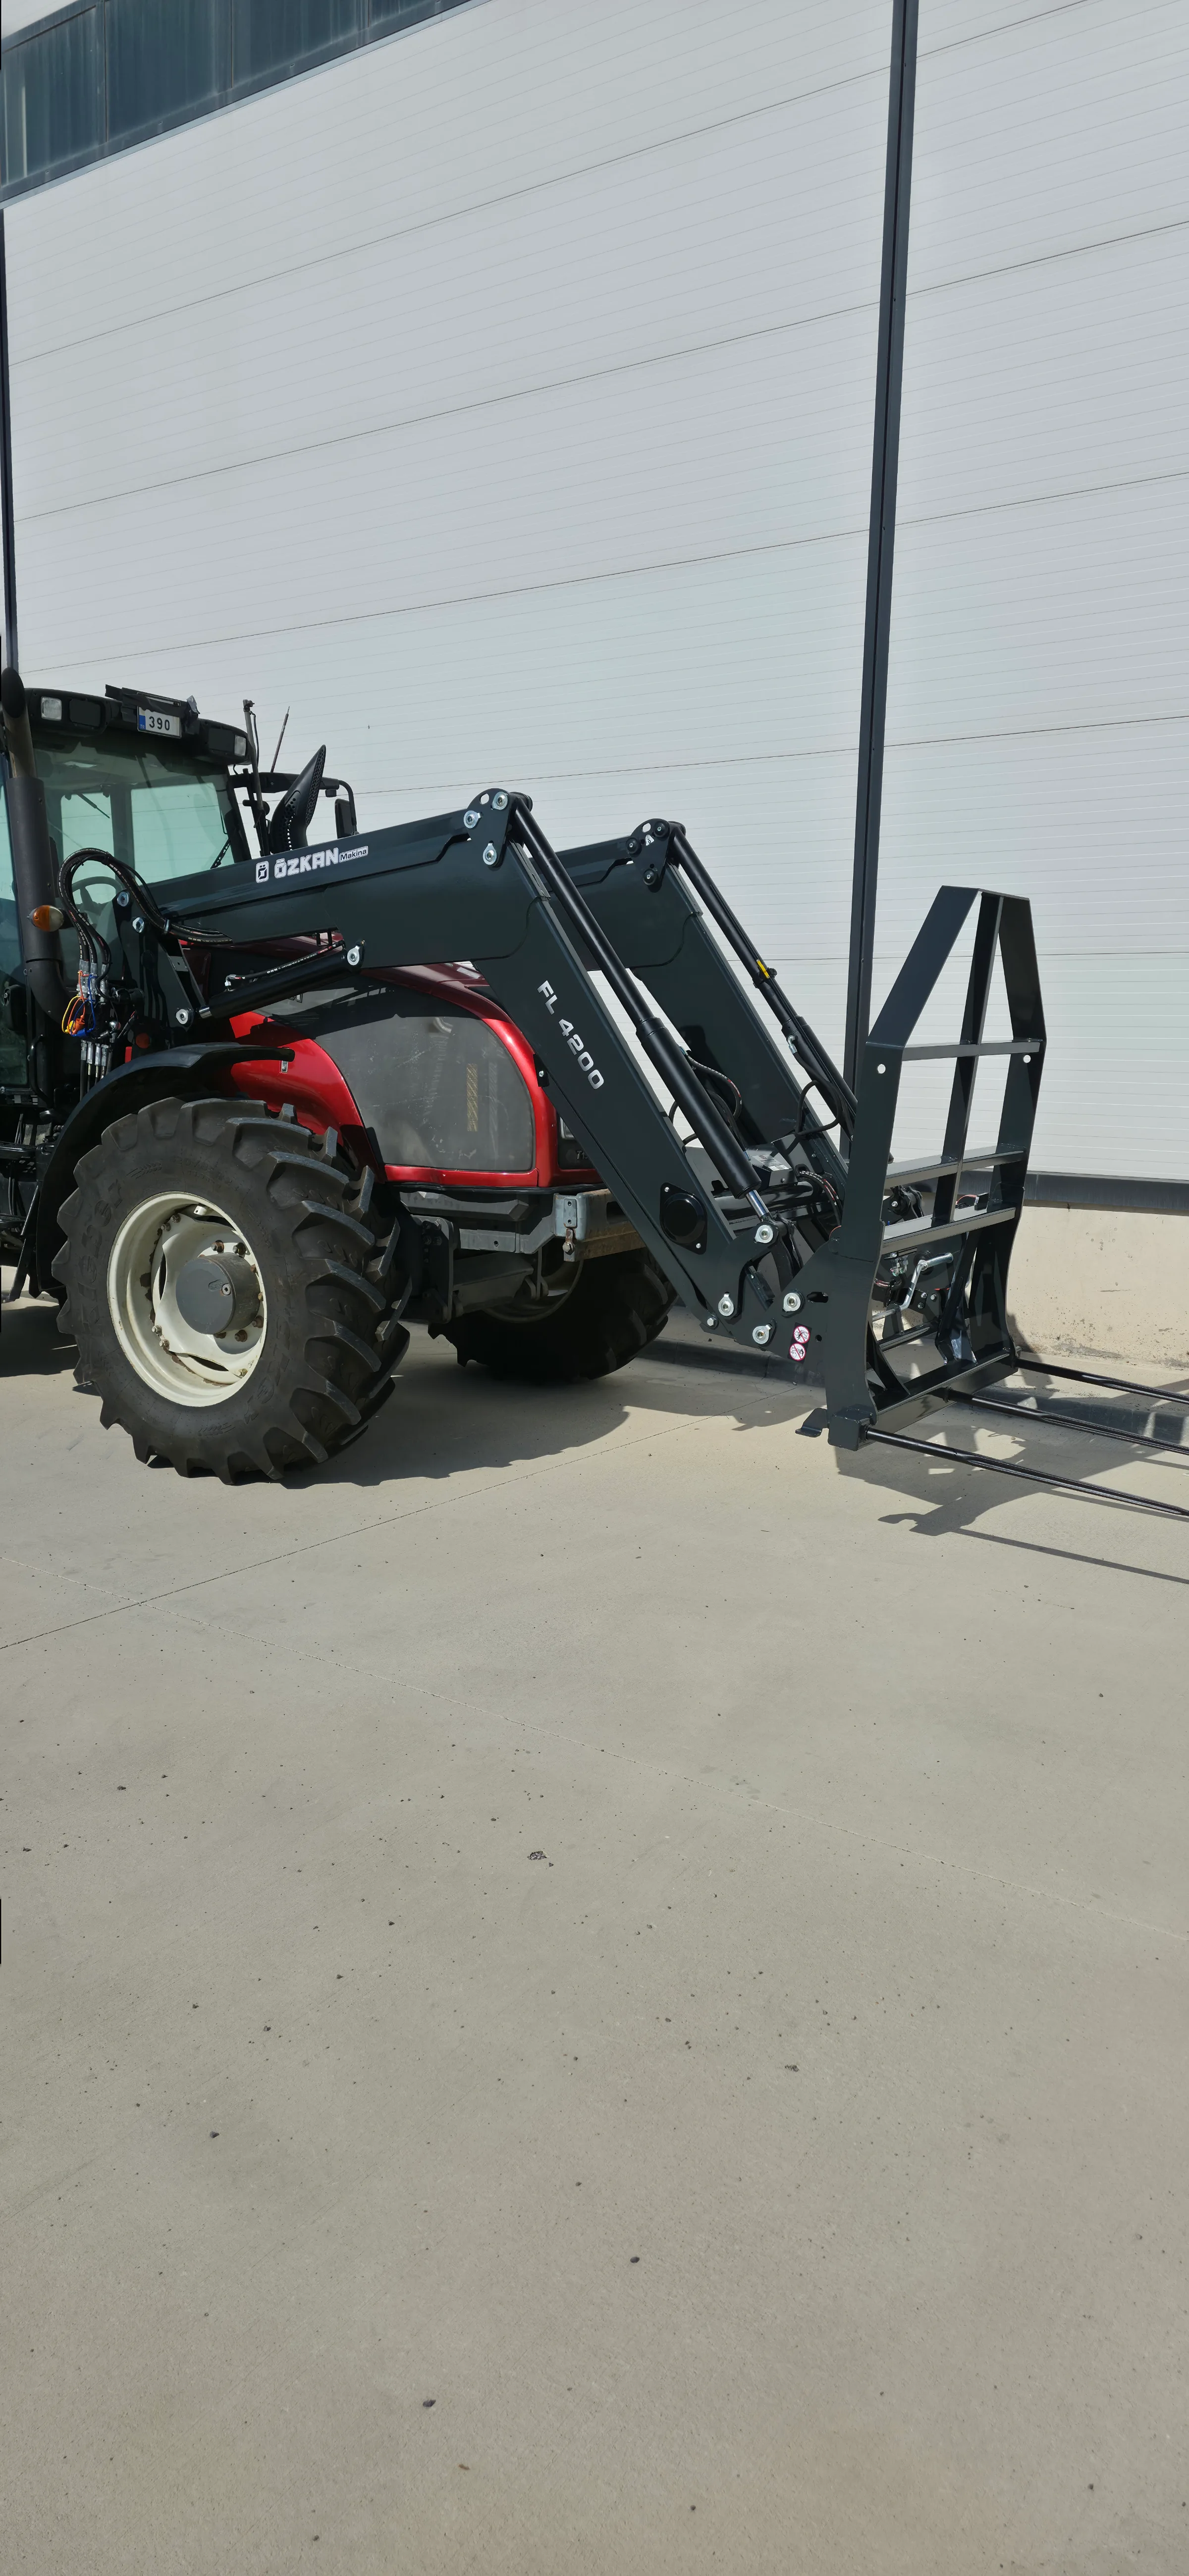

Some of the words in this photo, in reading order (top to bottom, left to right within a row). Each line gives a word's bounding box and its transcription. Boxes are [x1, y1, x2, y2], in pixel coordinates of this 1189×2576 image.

[149, 716, 170, 731] 390
[274, 848, 339, 879] ÖZKAN
[340, 848, 367, 861] Makina
[537, 980, 557, 1015] FL
[558, 1019, 604, 1089] 4200
